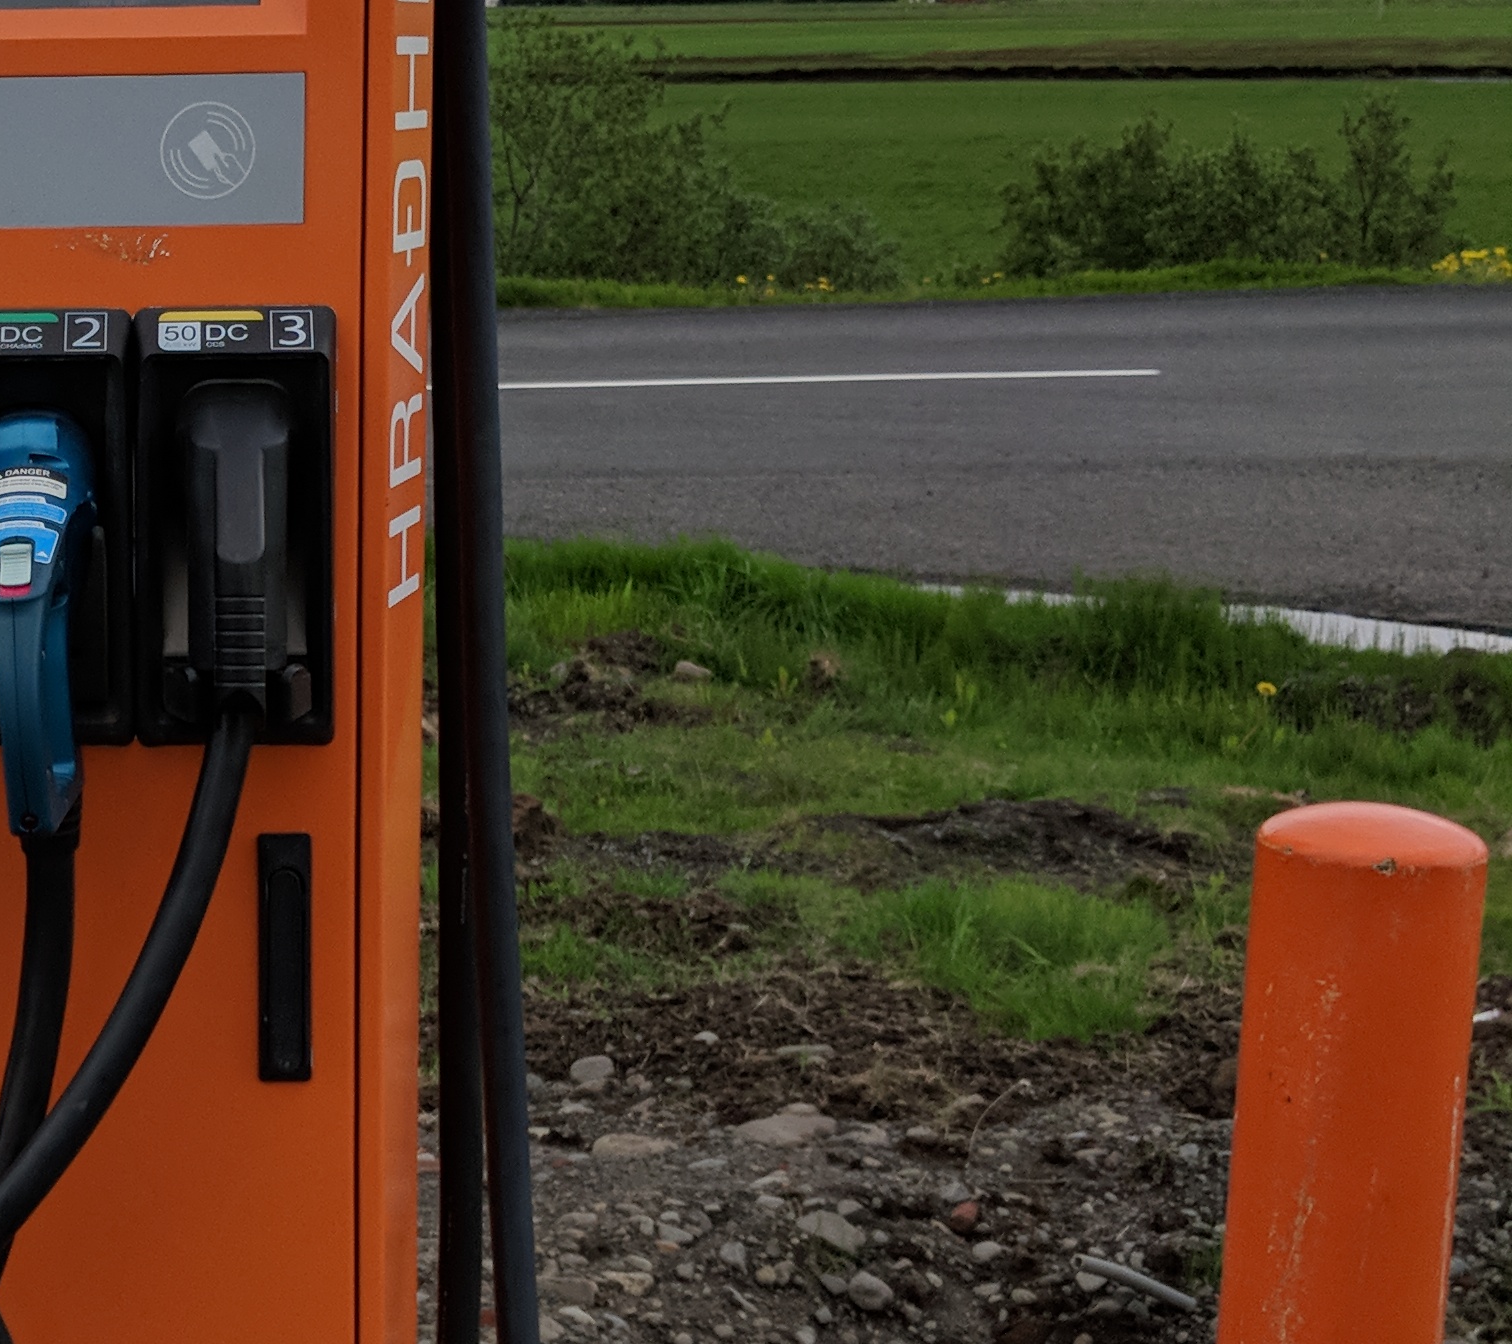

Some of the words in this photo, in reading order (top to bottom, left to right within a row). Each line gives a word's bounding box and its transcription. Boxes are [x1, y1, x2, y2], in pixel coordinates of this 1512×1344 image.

[0, 326, 43, 343] DC
[72, 317, 101, 348] 2
[164, 325, 197, 342] 50
[205, 323, 249, 342] DC
[278, 315, 308, 346] 3
[4, 467, 51, 477] DANGER
